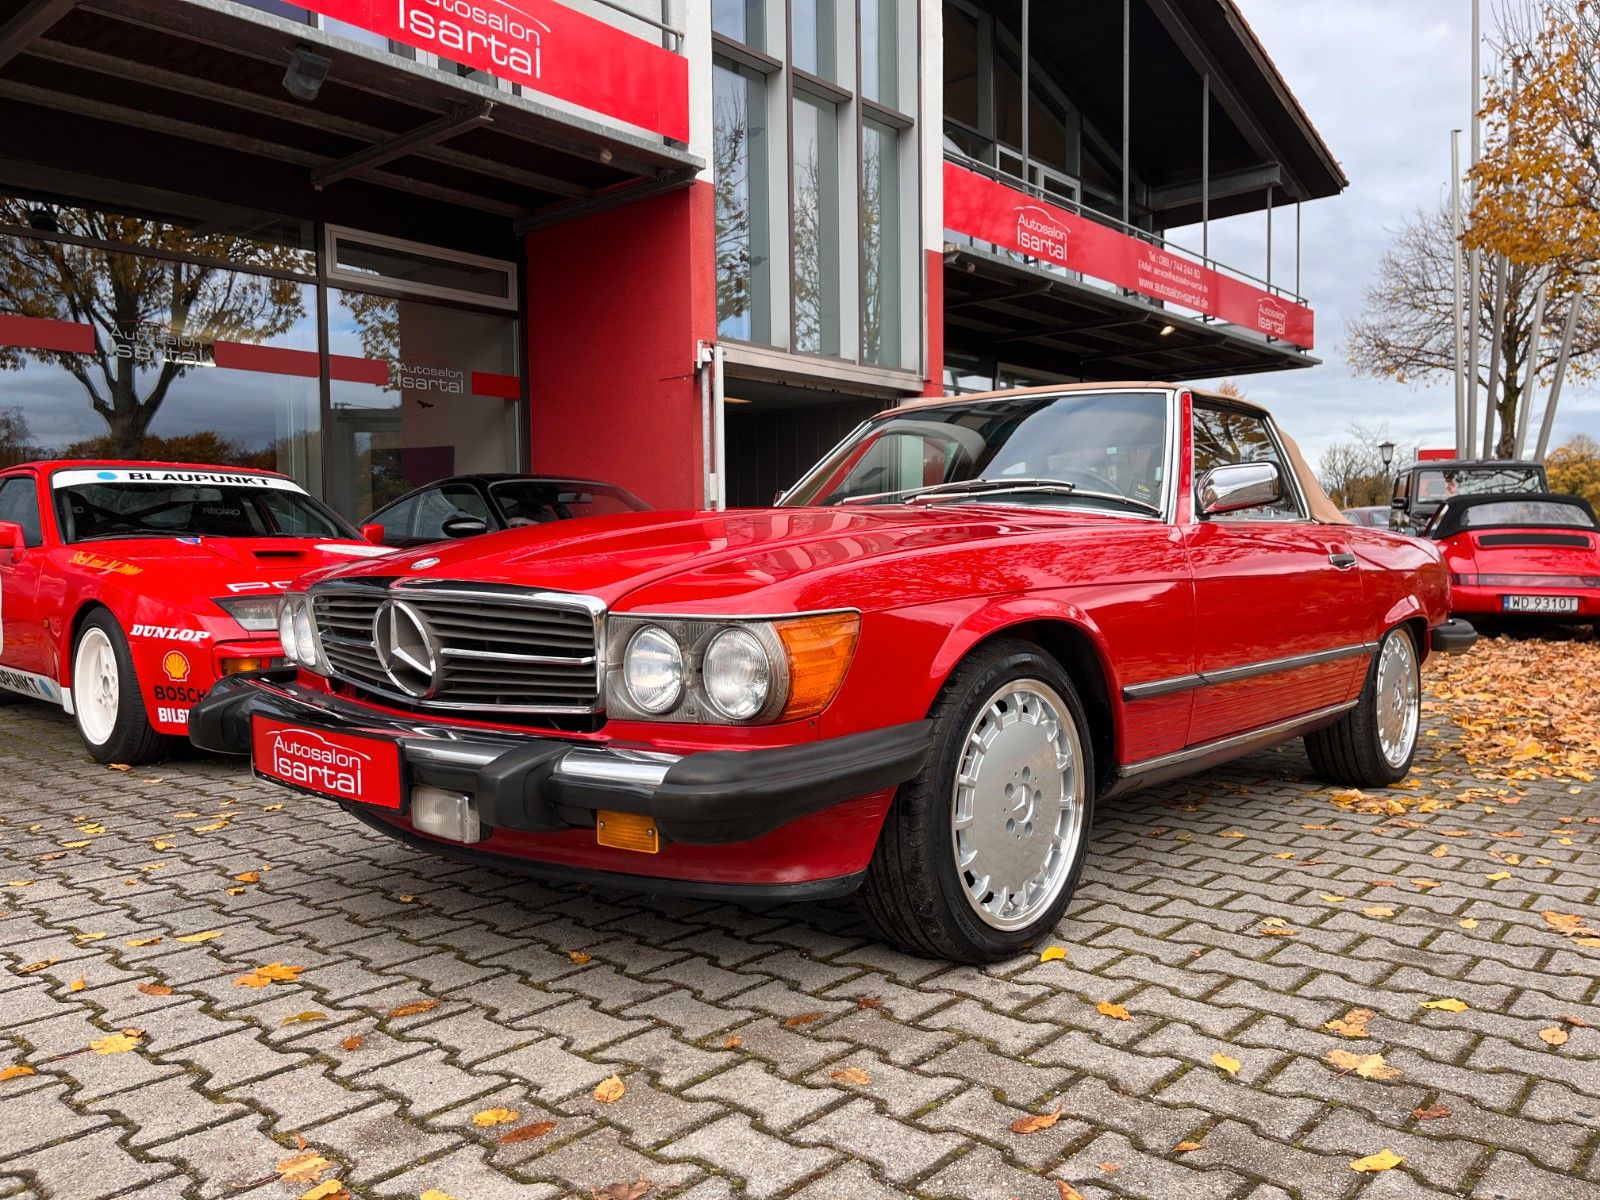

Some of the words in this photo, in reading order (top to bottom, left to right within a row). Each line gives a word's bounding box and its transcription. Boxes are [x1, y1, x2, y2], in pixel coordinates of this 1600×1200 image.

[398, 0, 541, 79] Isartal
[1017, 212, 1067, 242] Autosalon
[1017, 224, 1068, 262] Isartal
[1258, 311, 1286, 336] Isartal
[399, 362, 464, 379] Autosalon
[398, 374, 464, 394] Isartal
[128, 472, 270, 486] BLAUPUNKT
[202, 506, 241, 516] RECARO
[1512, 596, 1530, 609] WD
[1534, 597, 1576, 611] 9310T
[130, 624, 211, 643] DUNLOP
[154, 685, 207, 703] BOSCH
[273, 735, 362, 770] Autosalon
[273, 748, 362, 796] Isartal
